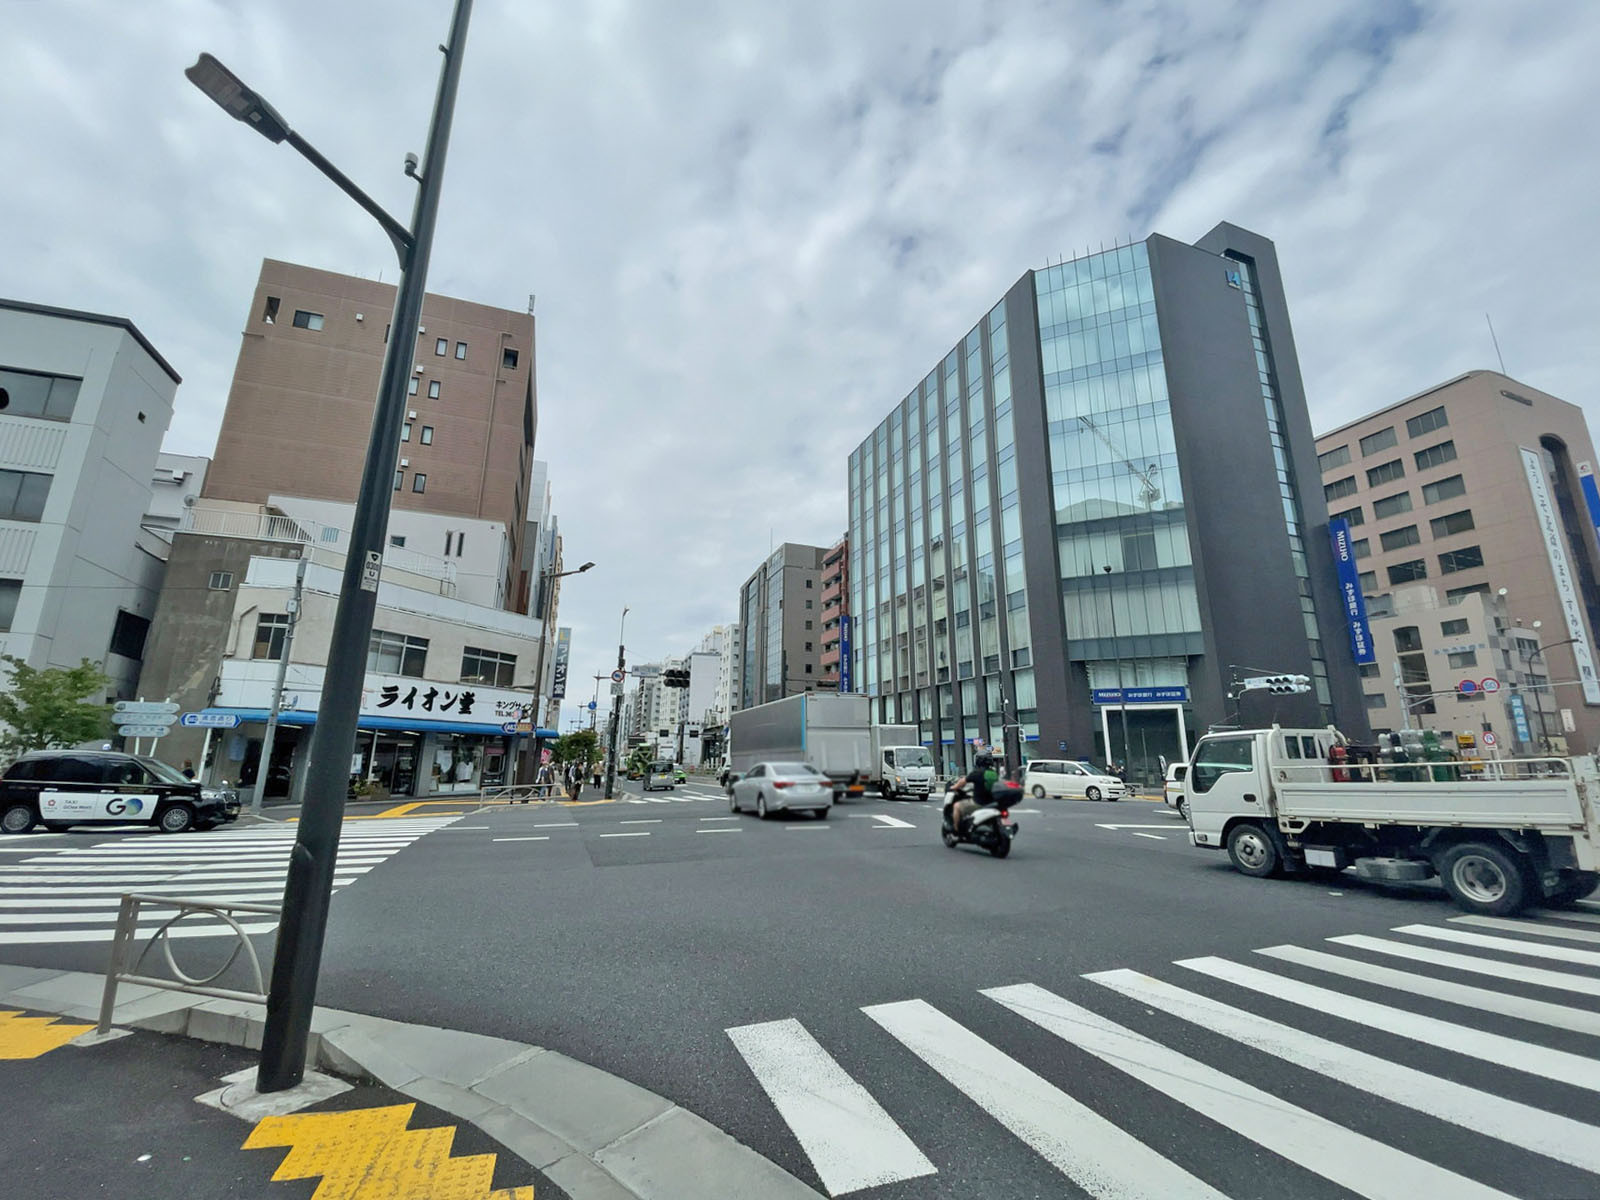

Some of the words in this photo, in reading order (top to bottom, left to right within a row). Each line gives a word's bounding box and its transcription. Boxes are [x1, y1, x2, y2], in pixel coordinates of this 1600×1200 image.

[1336, 530, 1349, 562] MIZUHO
[1345, 582, 1359, 616] みずほ銀行
[1353, 621, 1367, 656] みずほ証券
[554, 644, 568, 695] ライオン堂
[376, 685, 476, 715] ライオン堂
